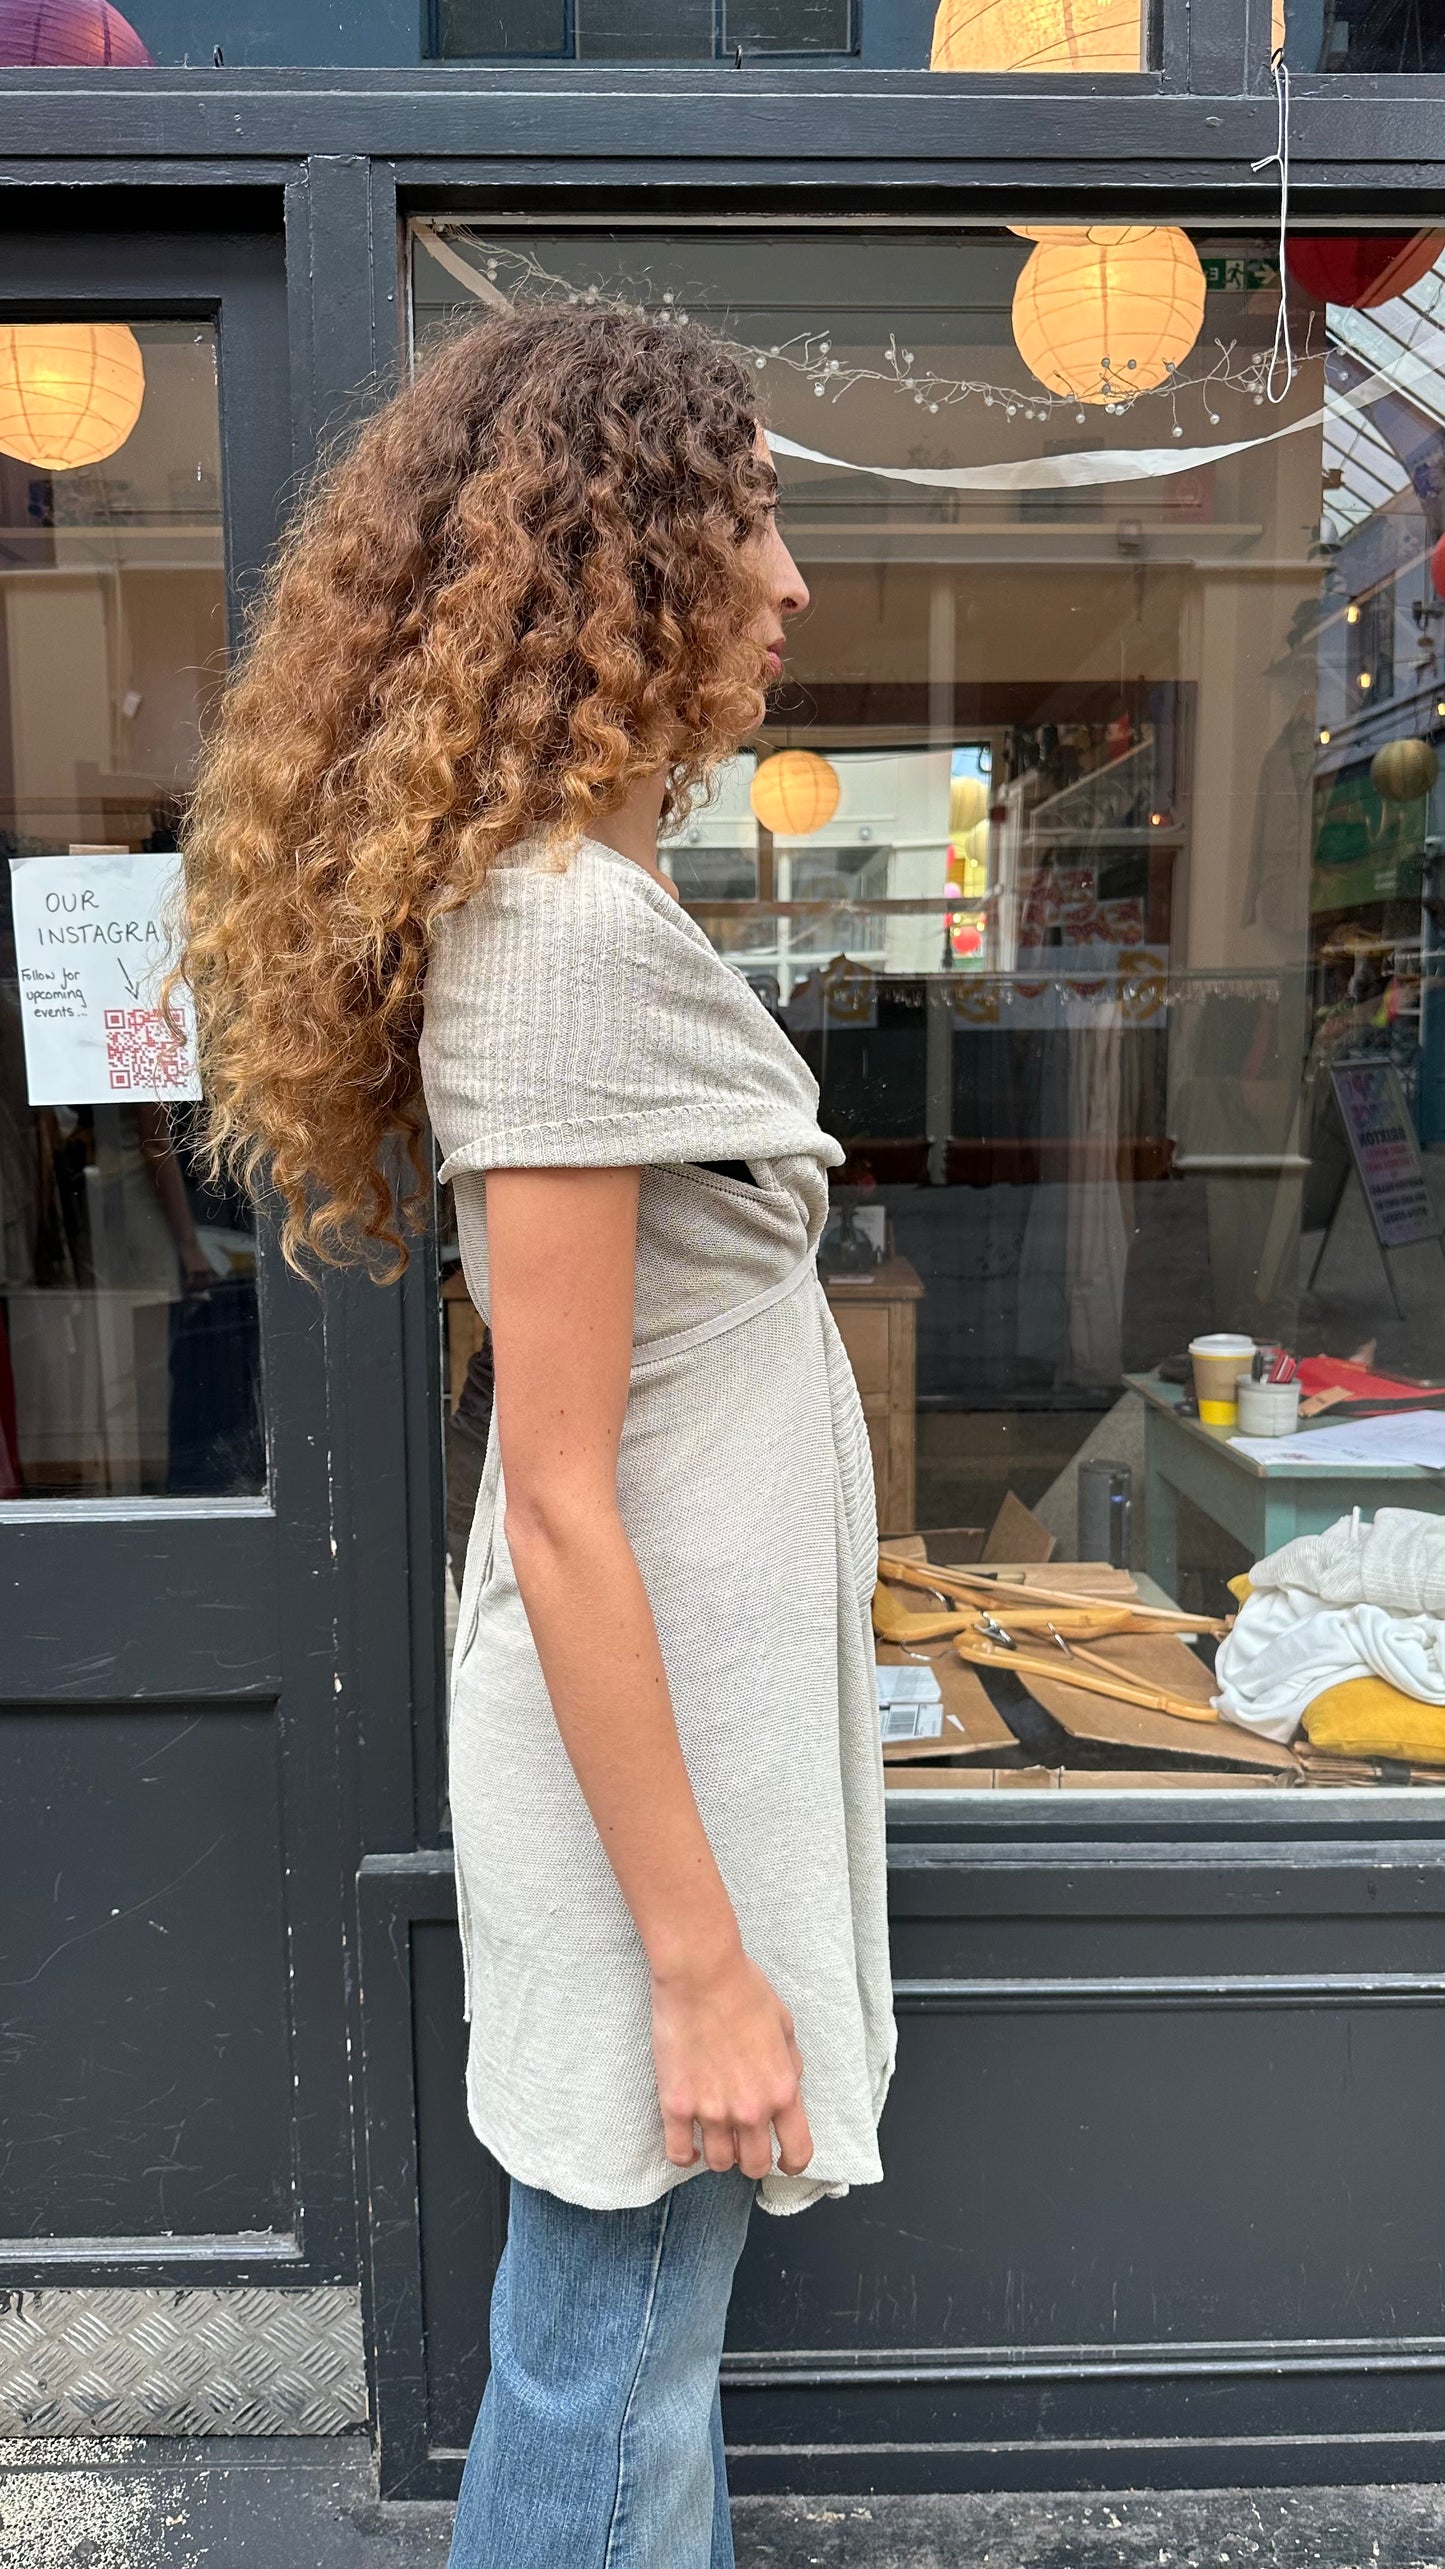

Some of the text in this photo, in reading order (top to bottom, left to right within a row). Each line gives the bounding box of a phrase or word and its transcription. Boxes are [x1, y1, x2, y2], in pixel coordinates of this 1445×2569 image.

[45, 890, 99, 912] OUR
[38, 920, 162, 945] INSTAGRA
[21, 967, 80, 989] Follow for
[26, 987, 87, 1008] upcoming
